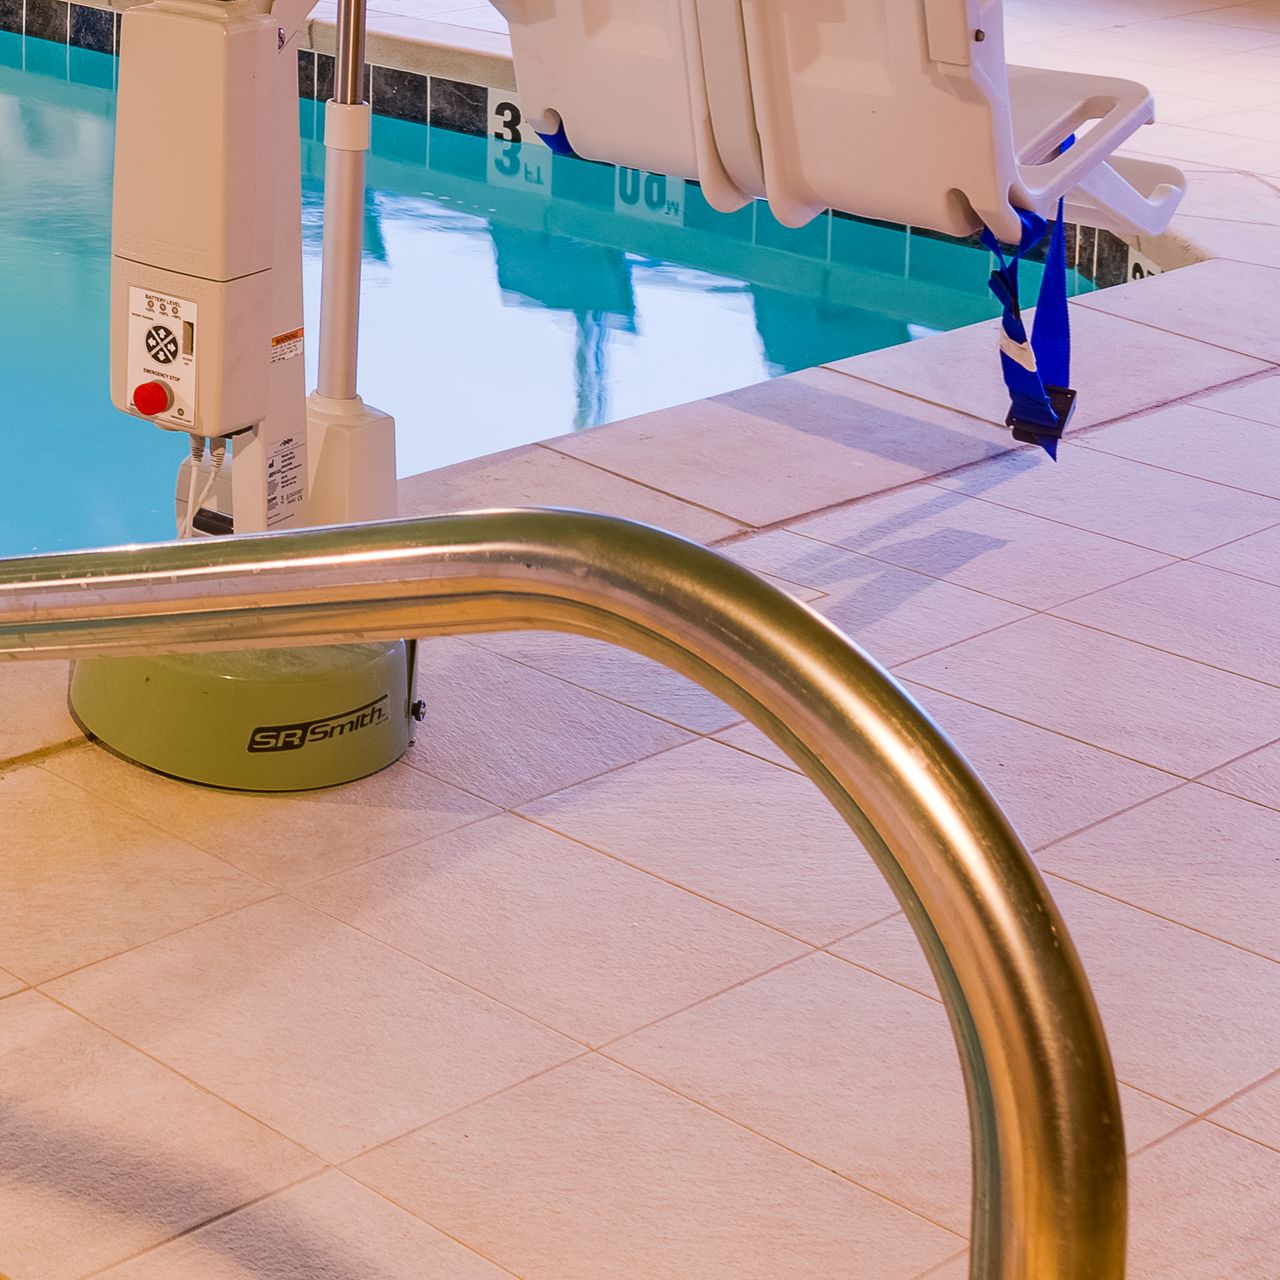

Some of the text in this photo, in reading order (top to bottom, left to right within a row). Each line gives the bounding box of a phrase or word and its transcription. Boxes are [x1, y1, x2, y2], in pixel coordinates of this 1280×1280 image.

[494, 102, 522, 143] 3
[145, 294, 181, 308] BATTERY LEVEL
[143, 368, 169, 378] EMERGENCY
